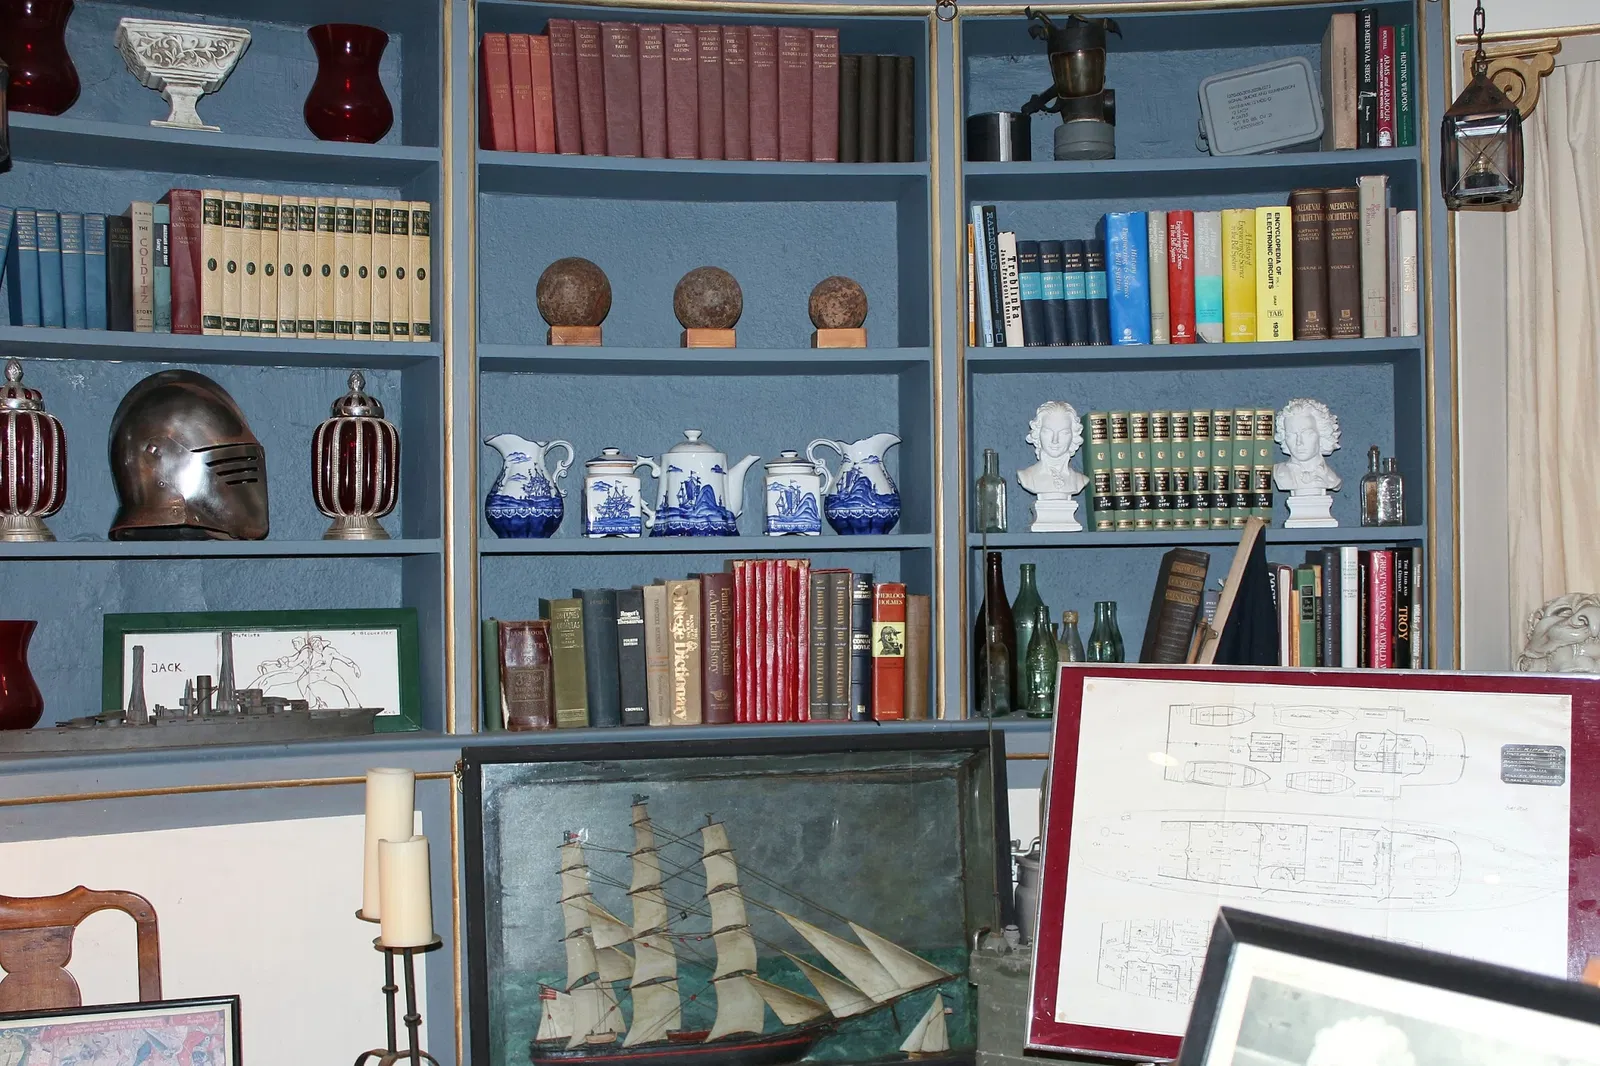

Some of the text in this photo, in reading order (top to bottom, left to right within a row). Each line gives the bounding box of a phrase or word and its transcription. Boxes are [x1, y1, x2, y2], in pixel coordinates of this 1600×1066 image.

[1329, 202, 1356, 210] MEDIEVAL
[986, 212, 998, 270] RAILROADS
[140, 238, 148, 303] COLDITZ
[1008, 256, 1020, 319] Treblinka
[1276, 267, 1282, 275] OF
[709, 597, 720, 640] American
[720, 588, 731, 676] Family Encyclopedia
[1398, 606, 1408, 641] TROY
[670, 584, 689, 720] College Dictionary
[708, 641, 720, 674] History
